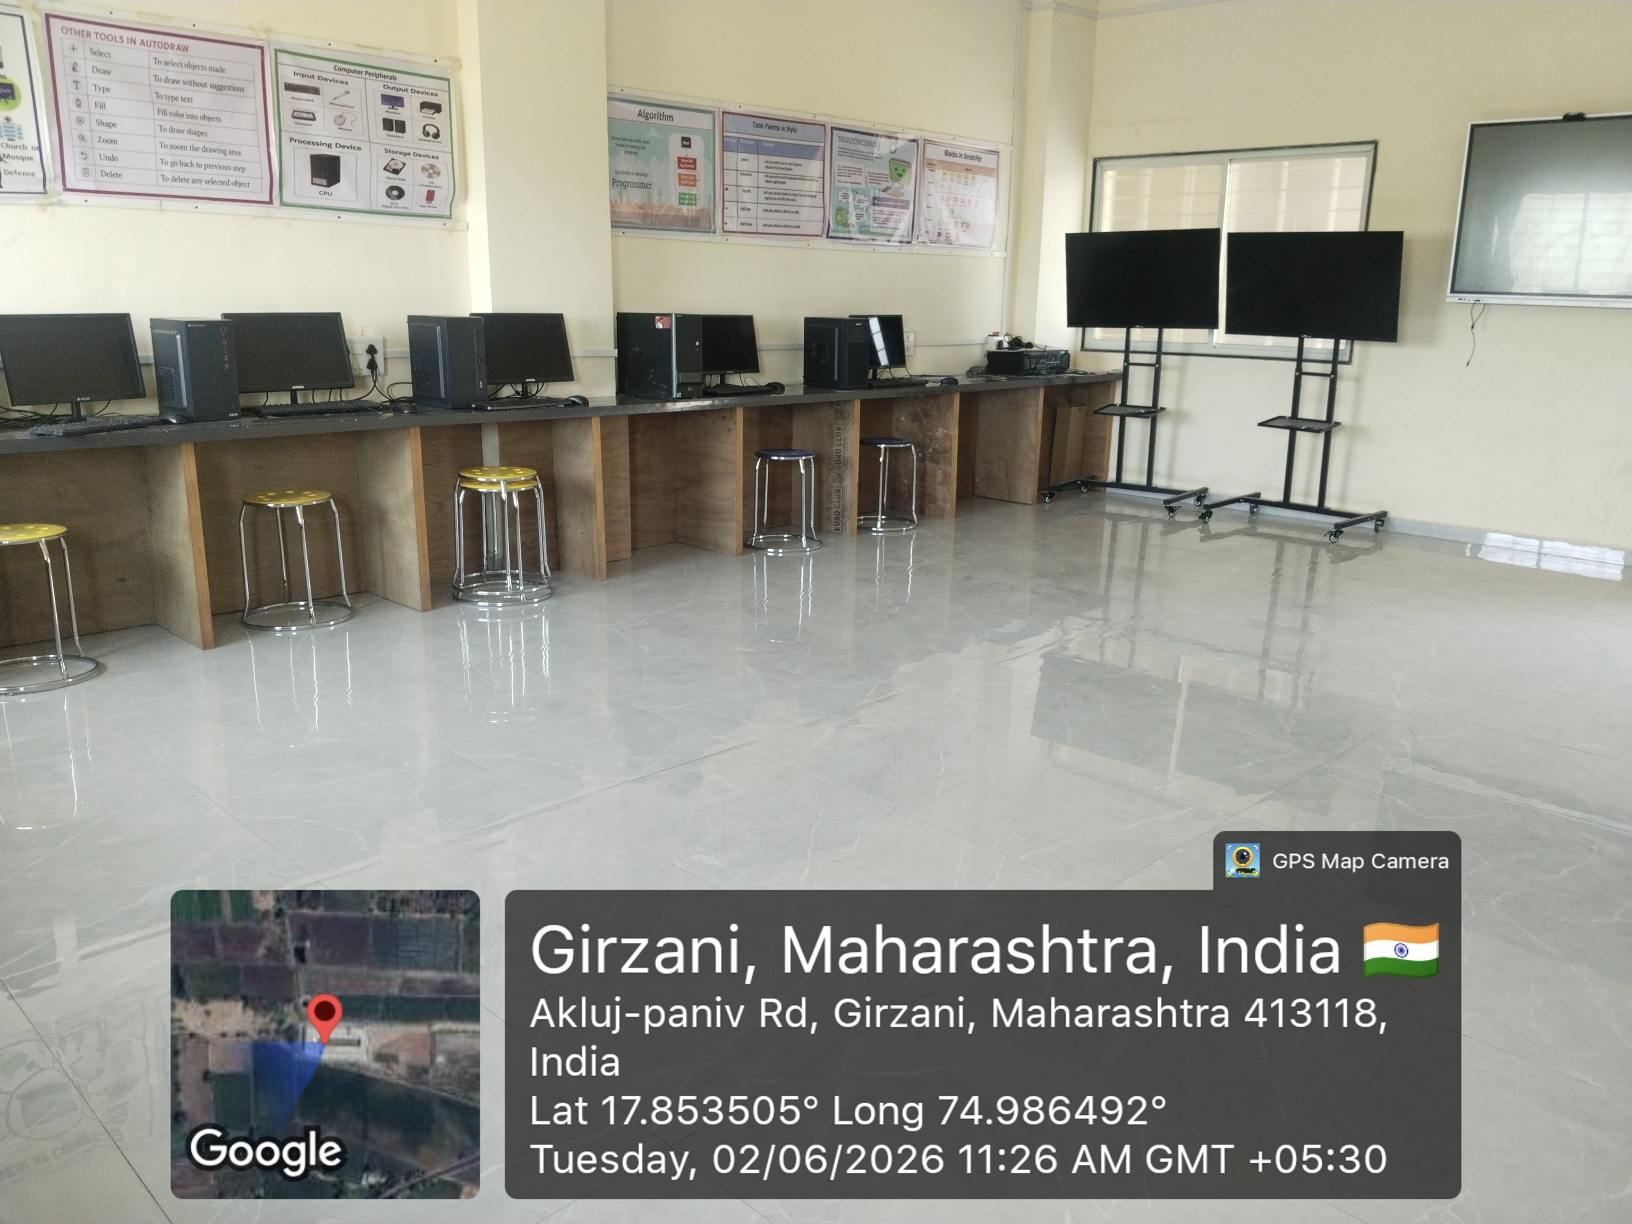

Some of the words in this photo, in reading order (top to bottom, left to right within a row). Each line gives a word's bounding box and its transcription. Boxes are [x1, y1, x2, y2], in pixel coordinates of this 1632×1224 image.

[61, 26, 92, 39] OTHER
[94, 31, 124, 44] TOOLS
[126, 36, 137, 46] IN
[139, 38, 190, 53] AUTODRAW
[89, 47, 111, 59] Select
[92, 66, 112, 75] Draw
[153, 57, 162, 65] To
[164, 59, 183, 68] select
[184, 62, 207, 72] objects
[208, 65, 226, 74] made
[293, 71, 315, 80] Input
[318, 76, 349, 86] Devices
[334, 65, 363, 76] Computer
[364, 69, 397, 81] Peripherals
[92, 83, 111, 94] Type
[153, 74, 162, 83] To
[164, 76, 181, 85] draw
[182, 79, 208, 89] without
[209, 83, 245, 93] suggestions
[383, 84, 409, 93] Output
[410, 89, 438, 97] Devices
[154, 92, 164, 100] To
[164, 94, 179, 103] type
[180, 95, 193, 103] text
[94, 101, 106, 110] Fill
[157, 108, 168, 116] Fill
[169, 110, 184, 118] color
[185, 112, 198, 120] into
[200, 113, 222, 123] objects
[637, 109, 674, 122] Algorithm
[95, 119, 118, 129] Shape
[765, 123, 781, 132] Palette
[158, 125, 168, 133] To
[169, 126, 185, 134] draw
[186, 128, 208, 138] shapes
[97, 135, 118, 145] Zoom
[289, 137, 332, 149] Processing
[335, 142, 362, 151] Device
[838, 136, 877, 148] SEQUENCING
[1, 142, 28, 151] Church
[159, 141, 168, 149] To
[189, 144, 200, 152] the
[201, 145, 227, 156] drawing
[2, 153, 34, 162] Mosque
[99, 153, 118, 162] Undo
[384, 148, 411, 157] Storage
[413, 152, 439, 160] Devices
[944, 150, 958, 158] Blocks
[159, 158, 169, 166] To
[179, 160, 195, 168] back
[204, 163, 232, 171] previous
[233, 165, 246, 174] step
[100, 169, 123, 179] Delete
[160, 174, 169, 182] To
[171, 175, 190, 184] delete
[192, 178, 203, 186] any
[204, 178, 230, 186] selected
[231, 179, 250, 188] object
[612, 178, 652, 190] Programmer
[835, 426, 843, 447] CLUB
